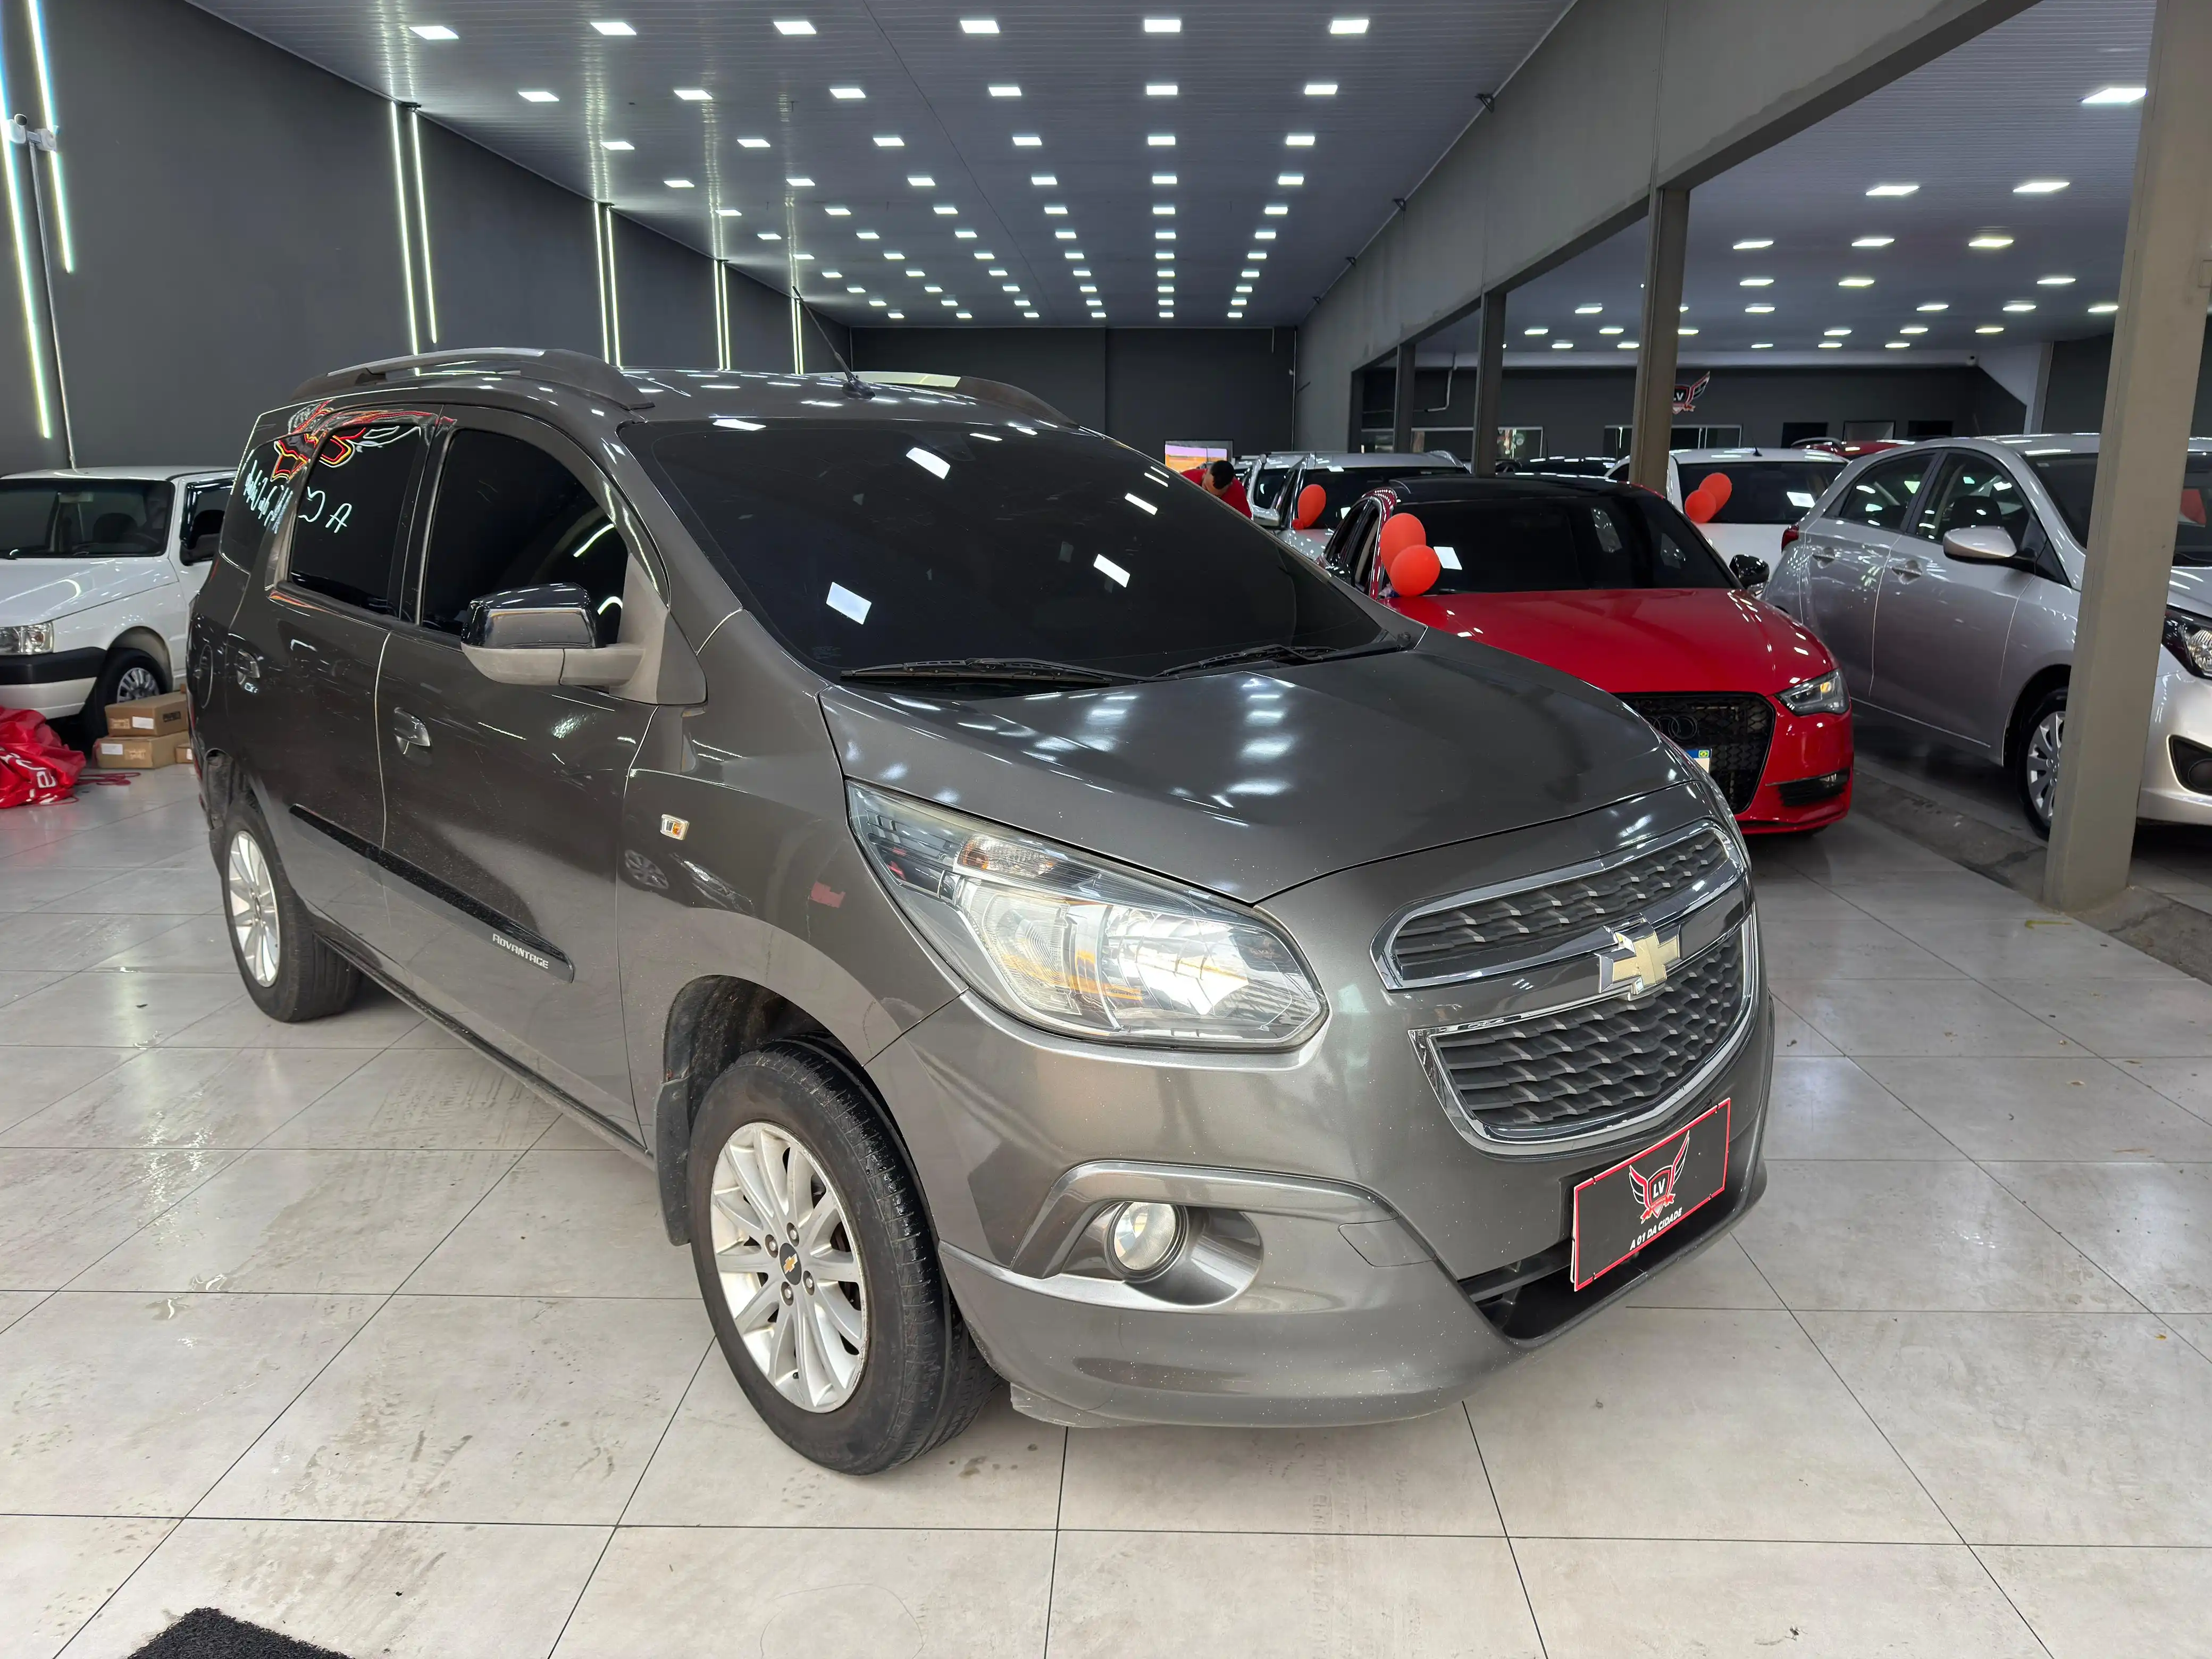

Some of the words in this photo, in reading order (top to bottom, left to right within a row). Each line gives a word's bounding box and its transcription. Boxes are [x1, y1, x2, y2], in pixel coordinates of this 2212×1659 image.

[492, 933, 549, 969] ADVANTAGE
[1653, 1178, 1666, 1199] LV
[1629, 1239, 1636, 1251] A
[1637, 1231, 1646, 1246] 01
[1647, 1225, 1657, 1239] DA
[1658, 1207, 1683, 1231] CIDADE
